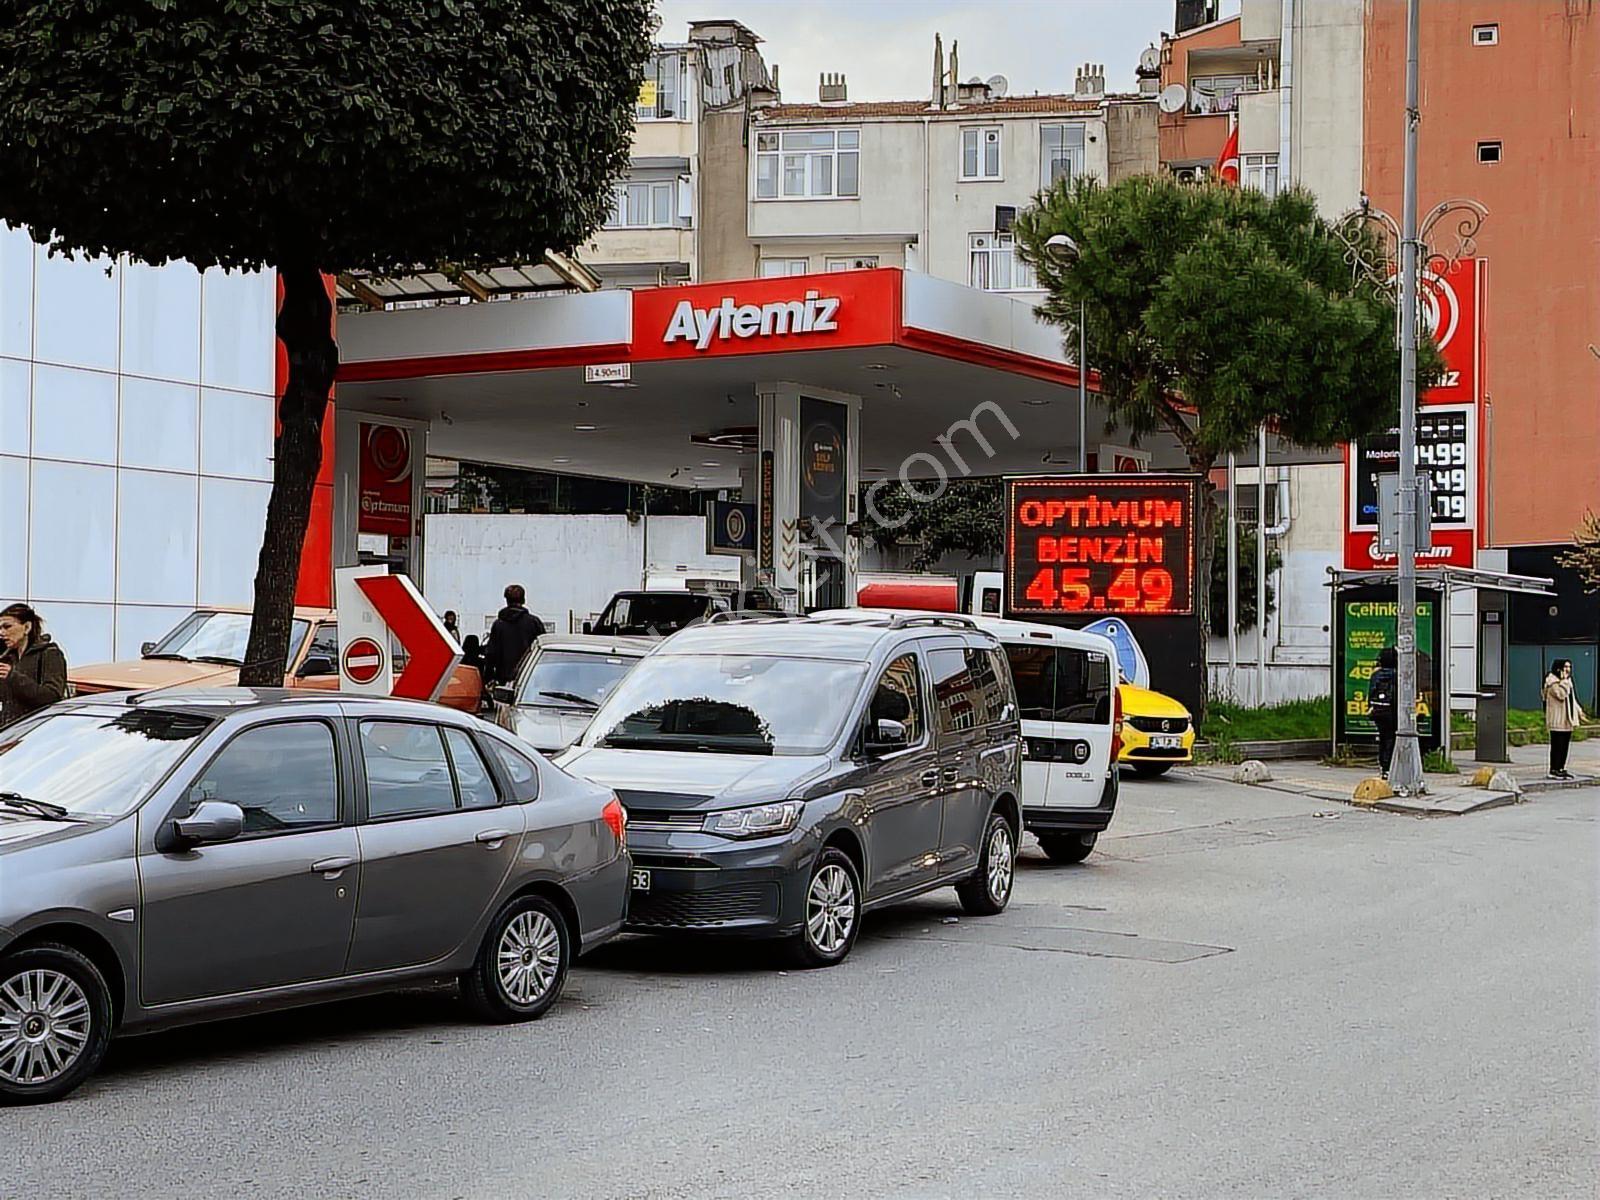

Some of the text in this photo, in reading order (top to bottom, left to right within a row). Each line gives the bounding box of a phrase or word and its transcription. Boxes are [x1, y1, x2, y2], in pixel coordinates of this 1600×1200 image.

[663, 290, 840, 350] Aytemiz
[1019, 495, 1182, 527] OPTİMUM
[1038, 532, 1164, 563] BENZİN
[1026, 568, 1173, 611] 45.49
[1347, 602, 1430, 618] Çetinka.
